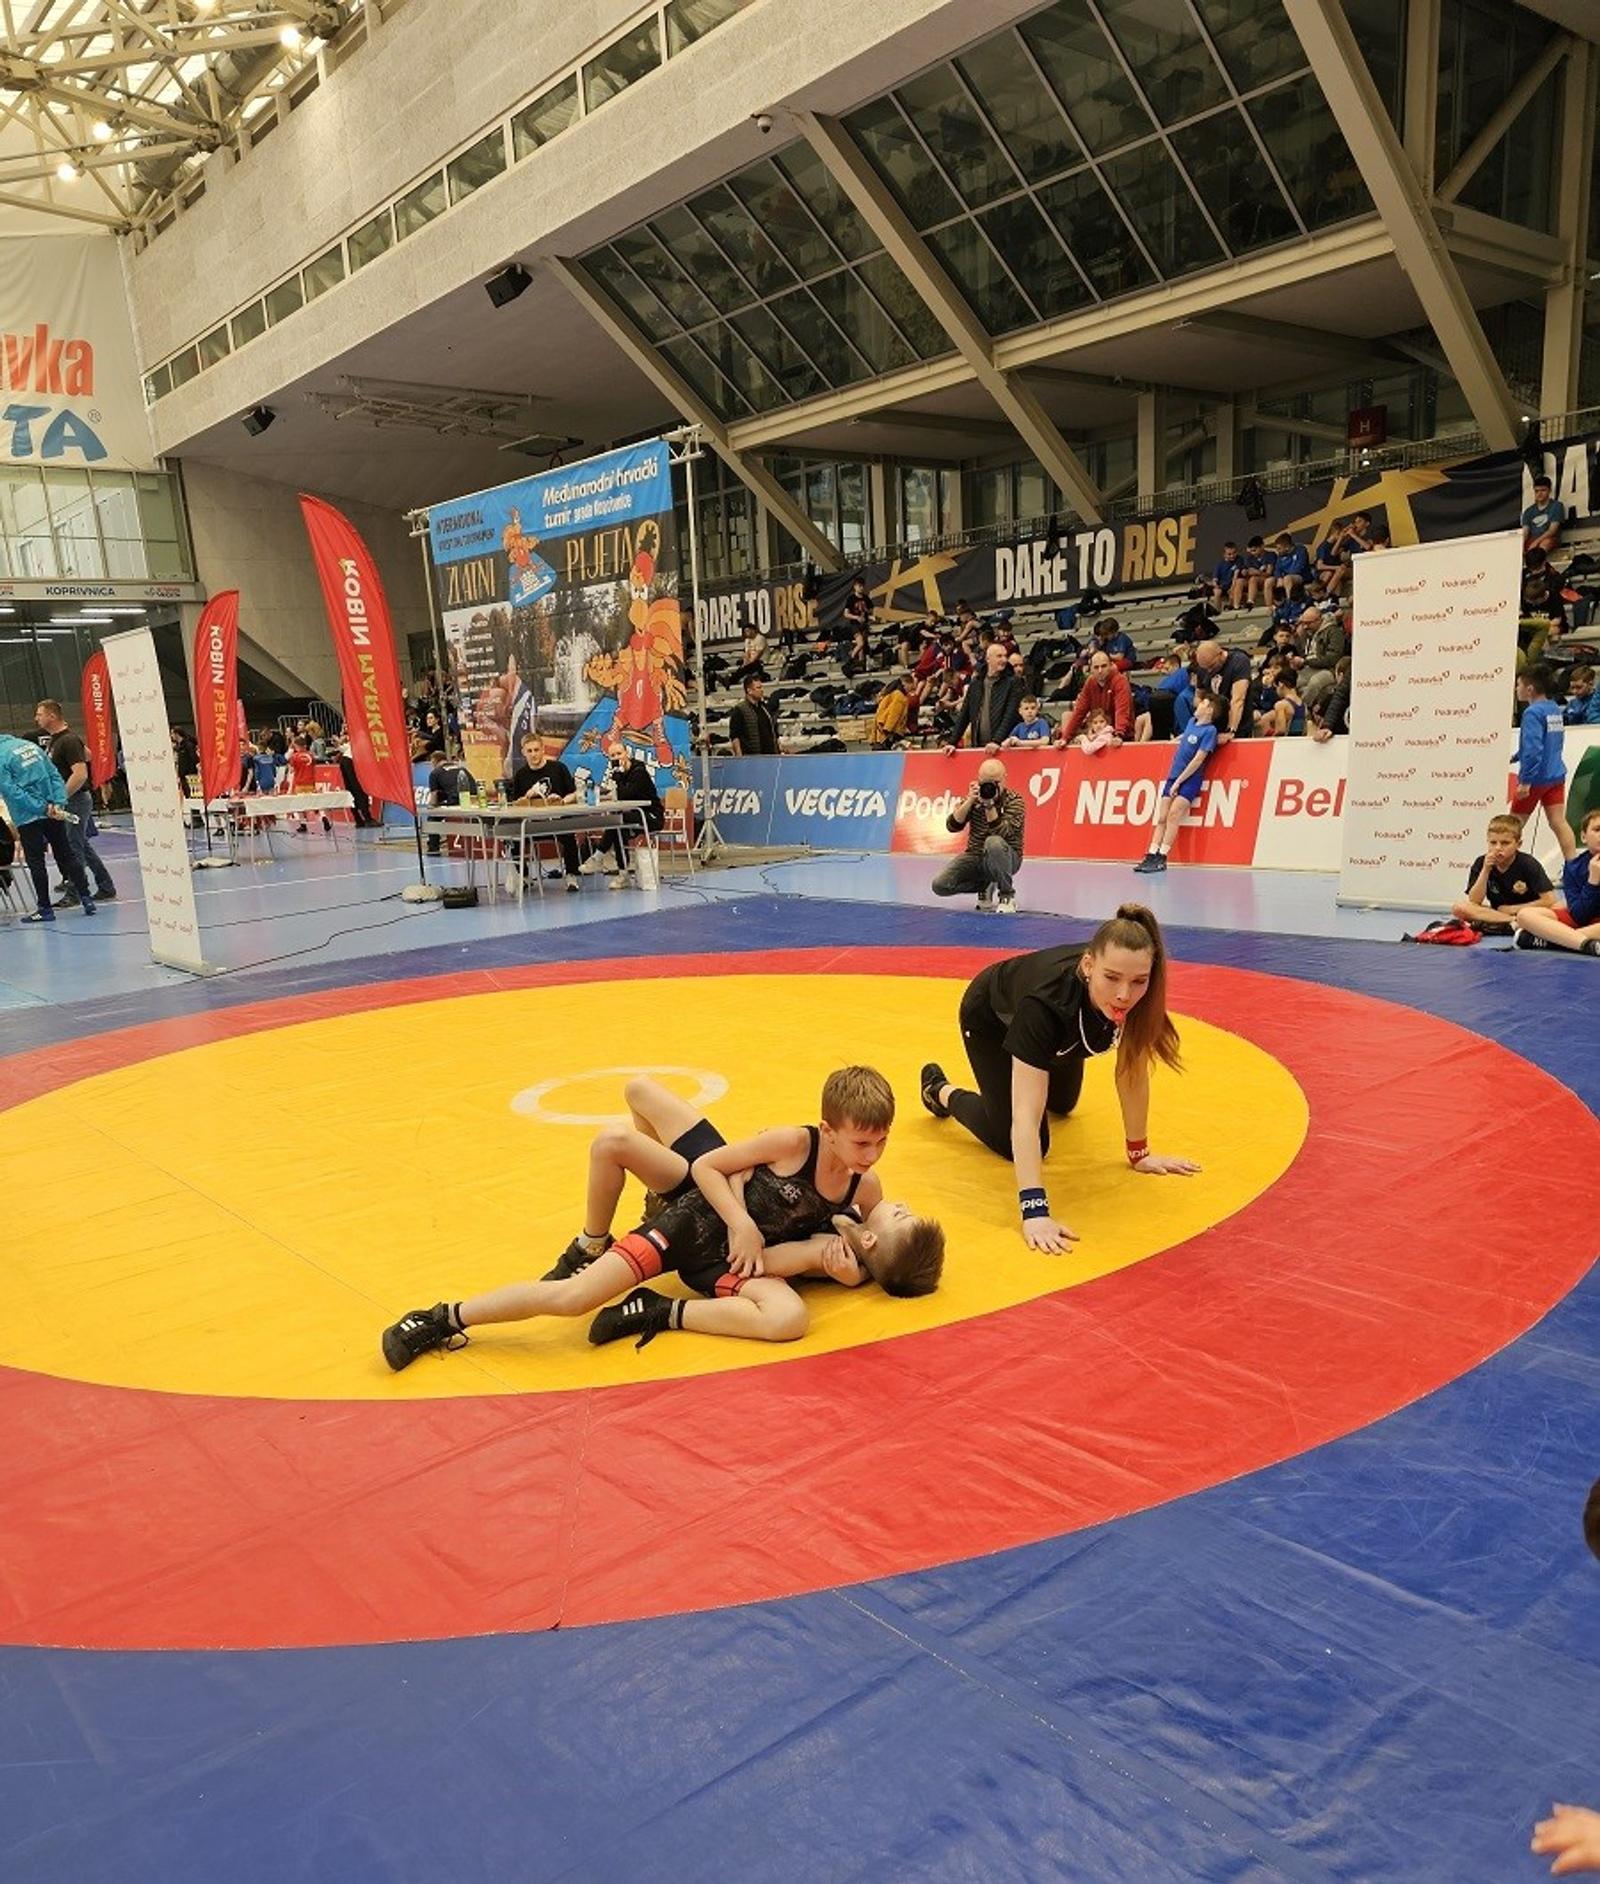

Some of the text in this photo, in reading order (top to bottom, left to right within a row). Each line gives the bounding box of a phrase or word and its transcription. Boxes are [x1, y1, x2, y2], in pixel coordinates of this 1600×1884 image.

[0, 324, 94, 396] vka
[1076, 528, 1116, 590] TO
[1122, 514, 1198, 583] RISE
[446, 558, 497, 605] ZLATNI
[699, 593, 743, 641] DARE
[745, 588, 771, 634] TO
[210, 625, 226, 685] ROBIN
[692, 788, 761, 818] EGETA
[785, 788, 887, 820] VEGETA
[898, 790, 961, 819] Podr
[1074, 779, 1242, 828] NEOEN
